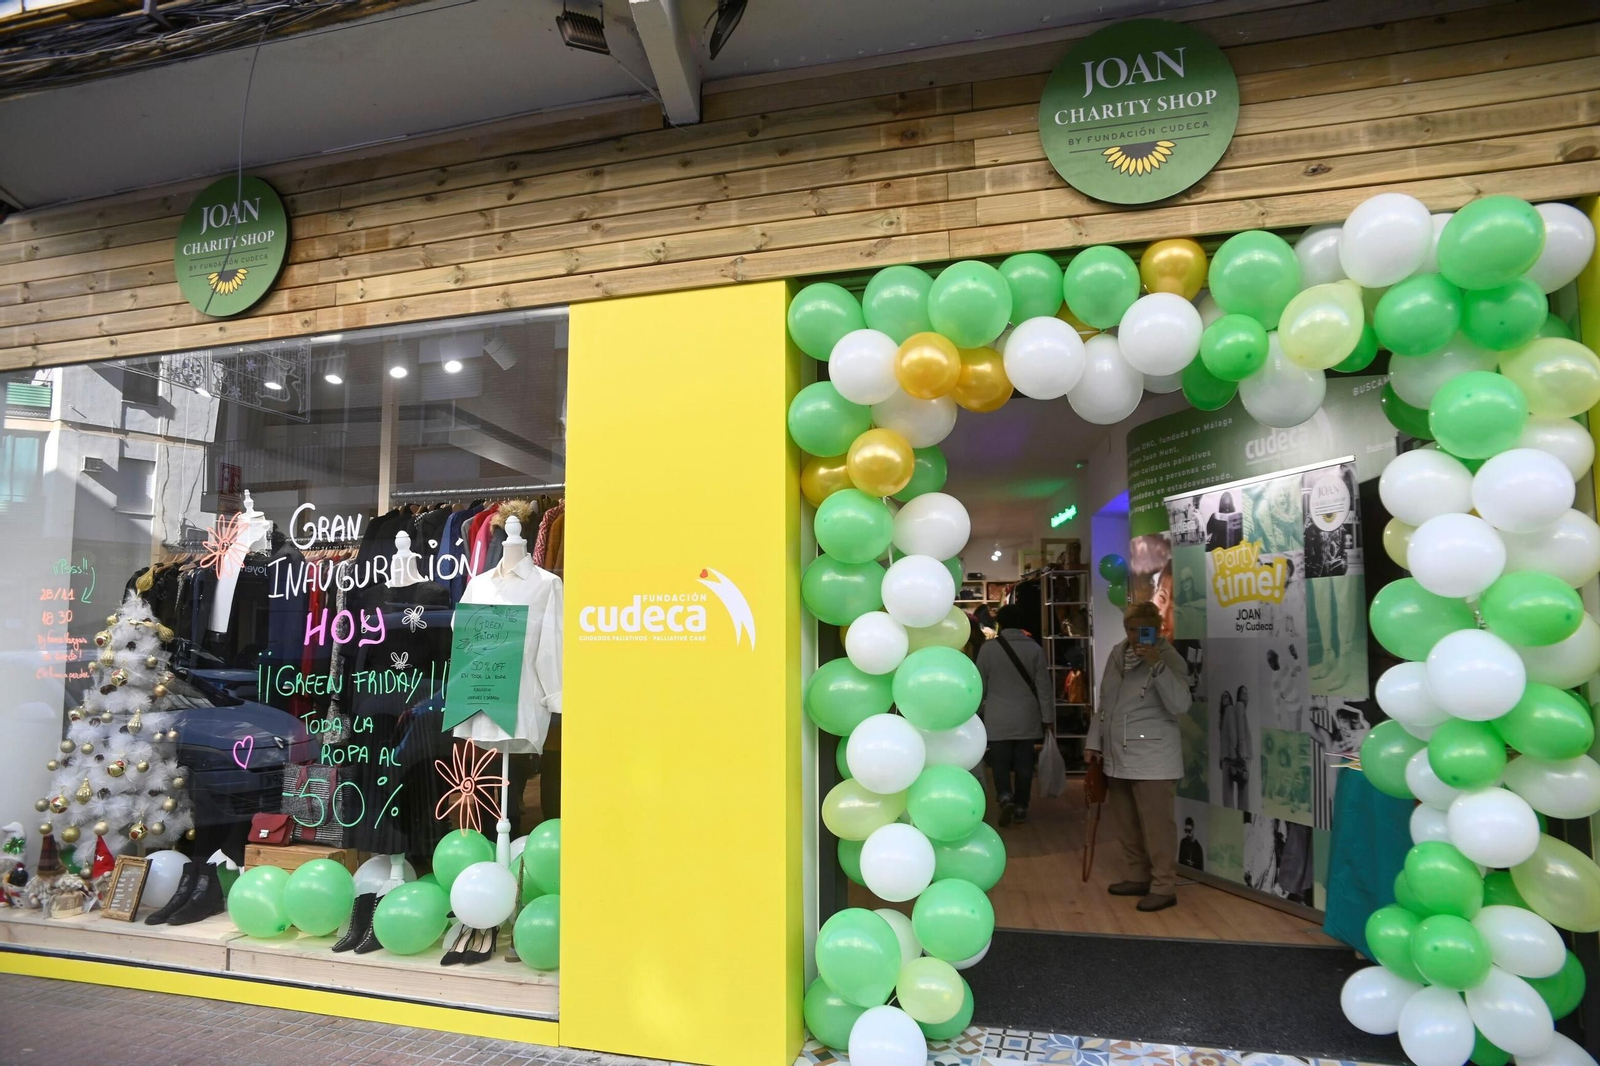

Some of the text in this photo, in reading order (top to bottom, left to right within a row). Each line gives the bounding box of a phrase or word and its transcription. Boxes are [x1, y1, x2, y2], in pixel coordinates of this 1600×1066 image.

[1081, 46, 1187, 99] JOAN
[1054, 89, 1218, 126] CHARITY SHOP
[1068, 120, 1210, 146] BY FUNDACIÓN CUDECA
[200, 197, 261, 235] JOAN
[183, 230, 275, 256] CHARITY SHOP
[241, 254, 268, 263] CUDECA
[1159, 430, 1189, 444] fundada
[1191, 427, 1201, 435] en
[1203, 418, 1233, 431] Málaga
[1245, 426, 1309, 459] cudeca
[1141, 461, 1171, 475] cuidados
[1173, 450, 1211, 467] paliativos
[1165, 466, 1200, 480] personas
[1202, 462, 1217, 471] con
[1157, 487, 1165, 495] en
[1318, 484, 1340, 498] JOAN
[289, 502, 362, 550] GRAN
[1214, 545, 1259, 573] Party
[39, 588, 75, 601] 28/11
[1216, 563, 1283, 603] time!
[642, 592, 707, 602] FUNDACIÓN
[474, 615, 504, 632] GREEN
[579, 594, 707, 633] cudeca
[1236, 608, 1261, 621] JOAN
[303, 606, 386, 648] HOY
[1235, 621, 1274, 633] by Cudeca
[491, 662, 507, 672] OFF
[300, 710, 374, 735] TODA LA
[320, 743, 402, 768] ROPA AL
[282, 776, 403, 829] -50%
